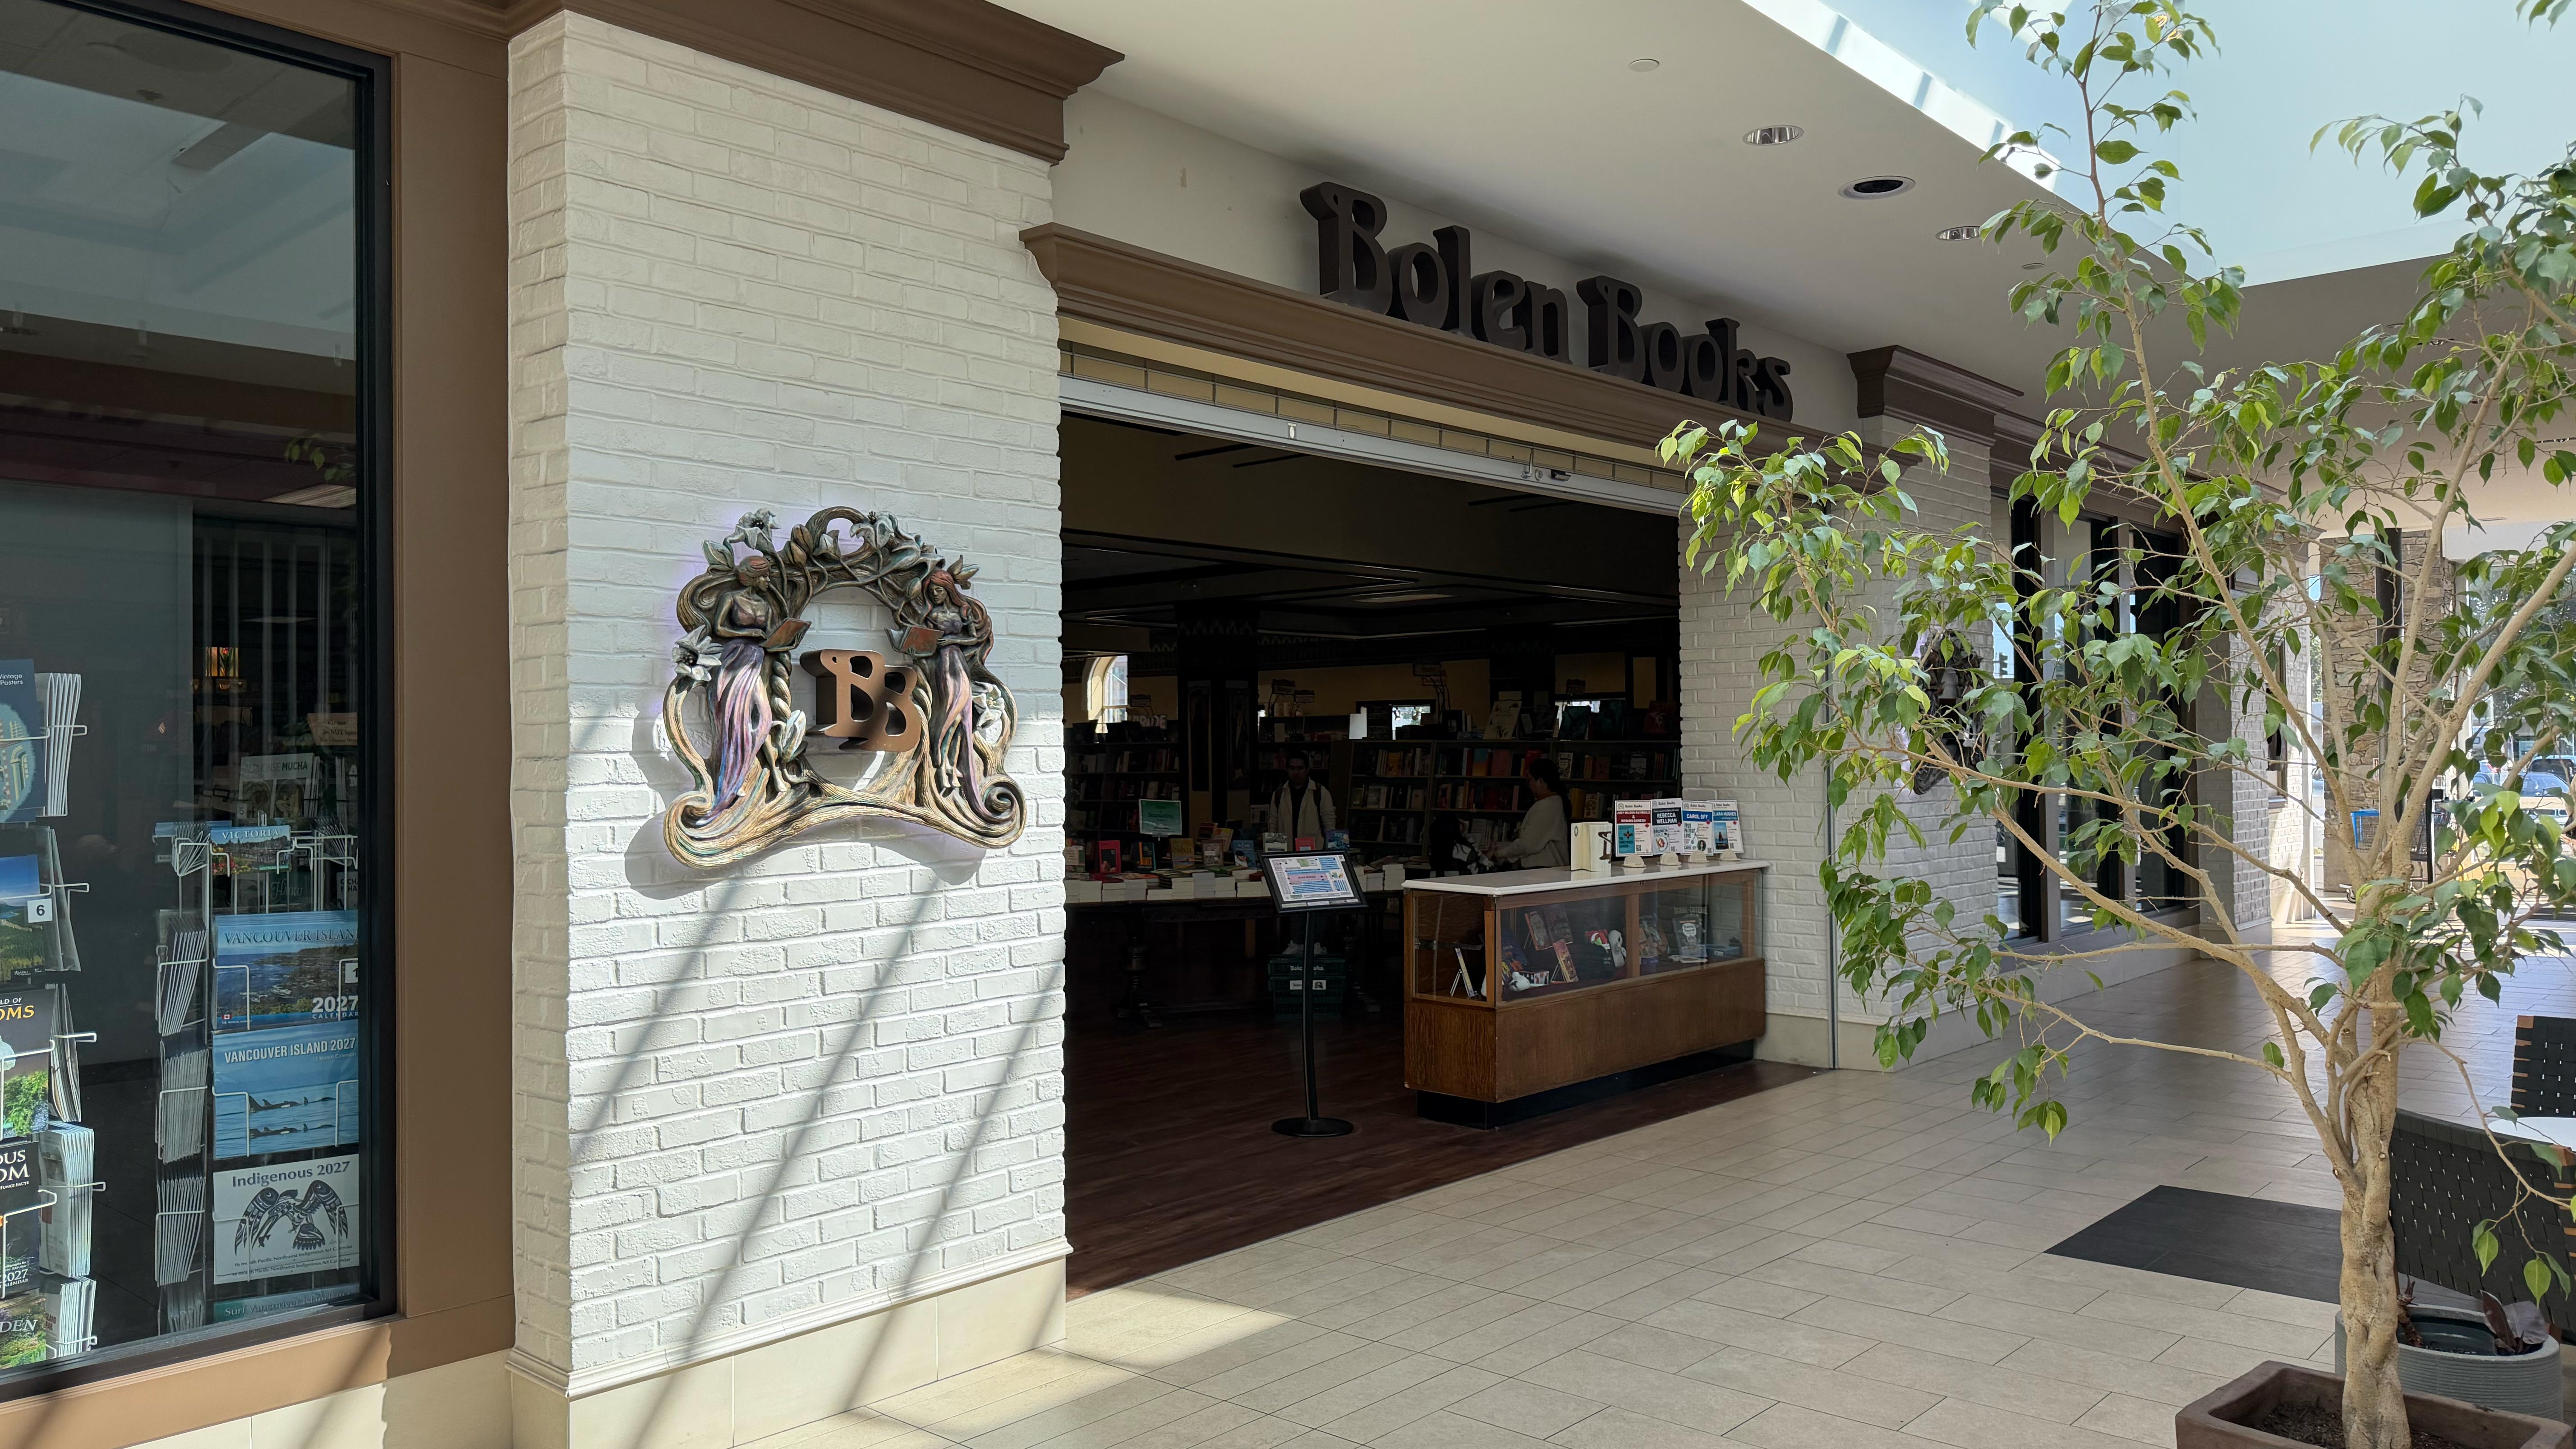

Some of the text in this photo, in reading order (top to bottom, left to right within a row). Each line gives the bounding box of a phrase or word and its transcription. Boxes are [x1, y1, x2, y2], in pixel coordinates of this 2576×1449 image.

[1300, 182, 1793, 423] Bolen Books
[282, 761, 308, 771] MUCHA
[222, 829, 280, 840] VICTORIA
[36, 905, 45, 916] 6
[224, 928, 358, 944] VANCOUVER ISLAN
[312, 995, 359, 1013] 2027
[225, 1037, 356, 1063] VANCOUVER ISLAND 2027
[233, 1161, 350, 1187] Indigenous 2027
[273, 1253, 298, 1261] Northwest
[299, 1248, 324, 1257] Indigenous
[271, 1263, 295, 1271] Northwest
[296, 1260, 321, 1268] Indigenous
[225, 1307, 245, 1316] Surf
[248, 1301, 299, 1313] Vancouver
[0, 1319, 38, 1334] DEN
